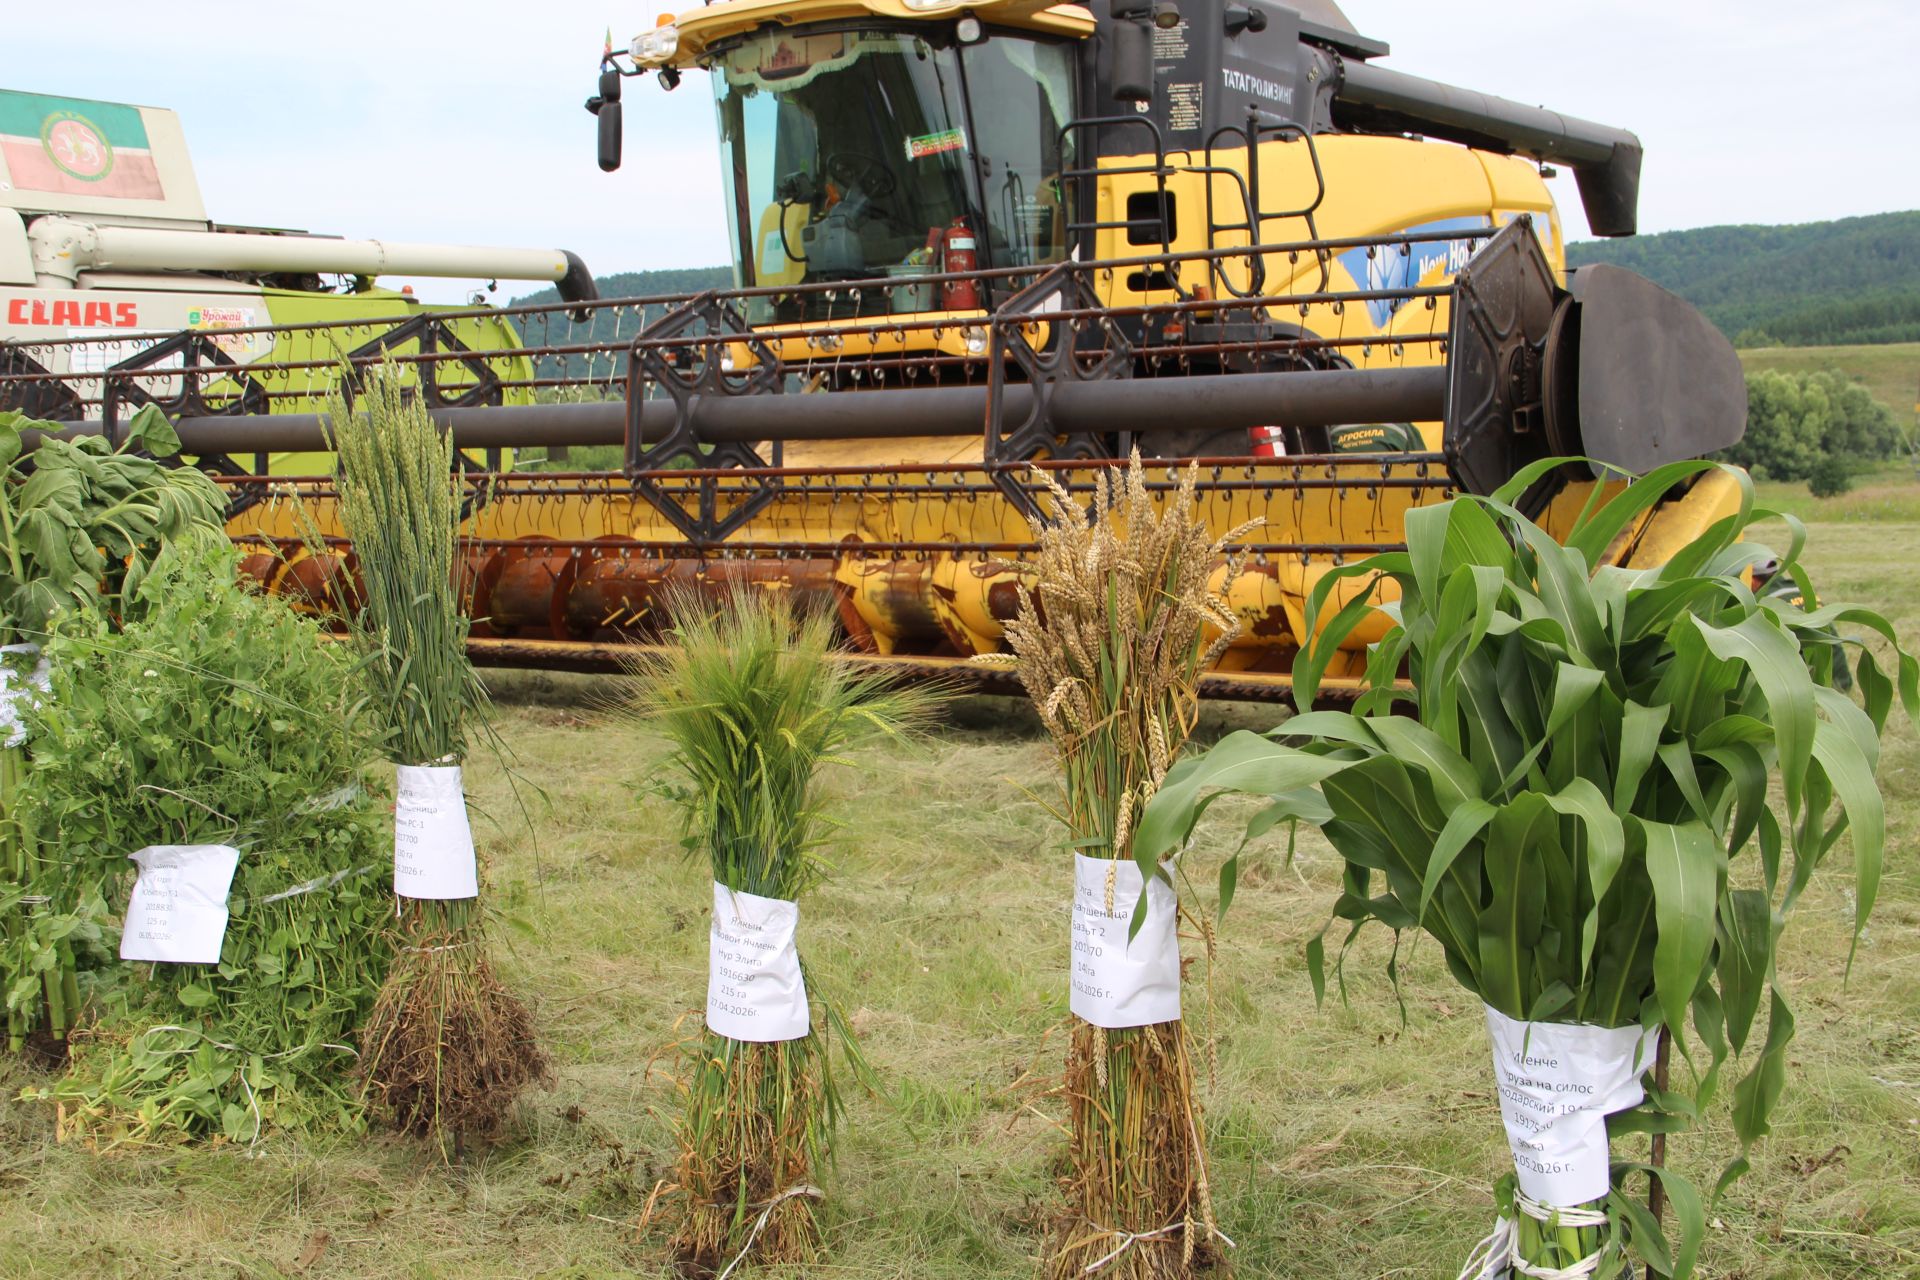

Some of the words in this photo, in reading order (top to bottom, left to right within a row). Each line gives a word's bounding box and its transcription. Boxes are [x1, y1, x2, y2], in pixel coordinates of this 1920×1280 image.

[1222, 68, 1294, 105] ТАТАГРОЛИЗИНГ
[8, 299, 137, 327] CLAAS
[202, 308, 241, 323] Урожай
[1338, 429, 1385, 444] АГРОСИЛА
[1099, 927, 1105, 936] 2
[743, 937, 778, 951] Ячмень
[718, 947, 733, 961] Нур
[735, 953, 762, 966] Элита
[721, 984, 735, 997] 215
[737, 991, 747, 999] га
[1511, 1051, 1558, 1068] Иенче
[1536, 1080, 1552, 1091] на
[1555, 1082, 1594, 1095] силос
